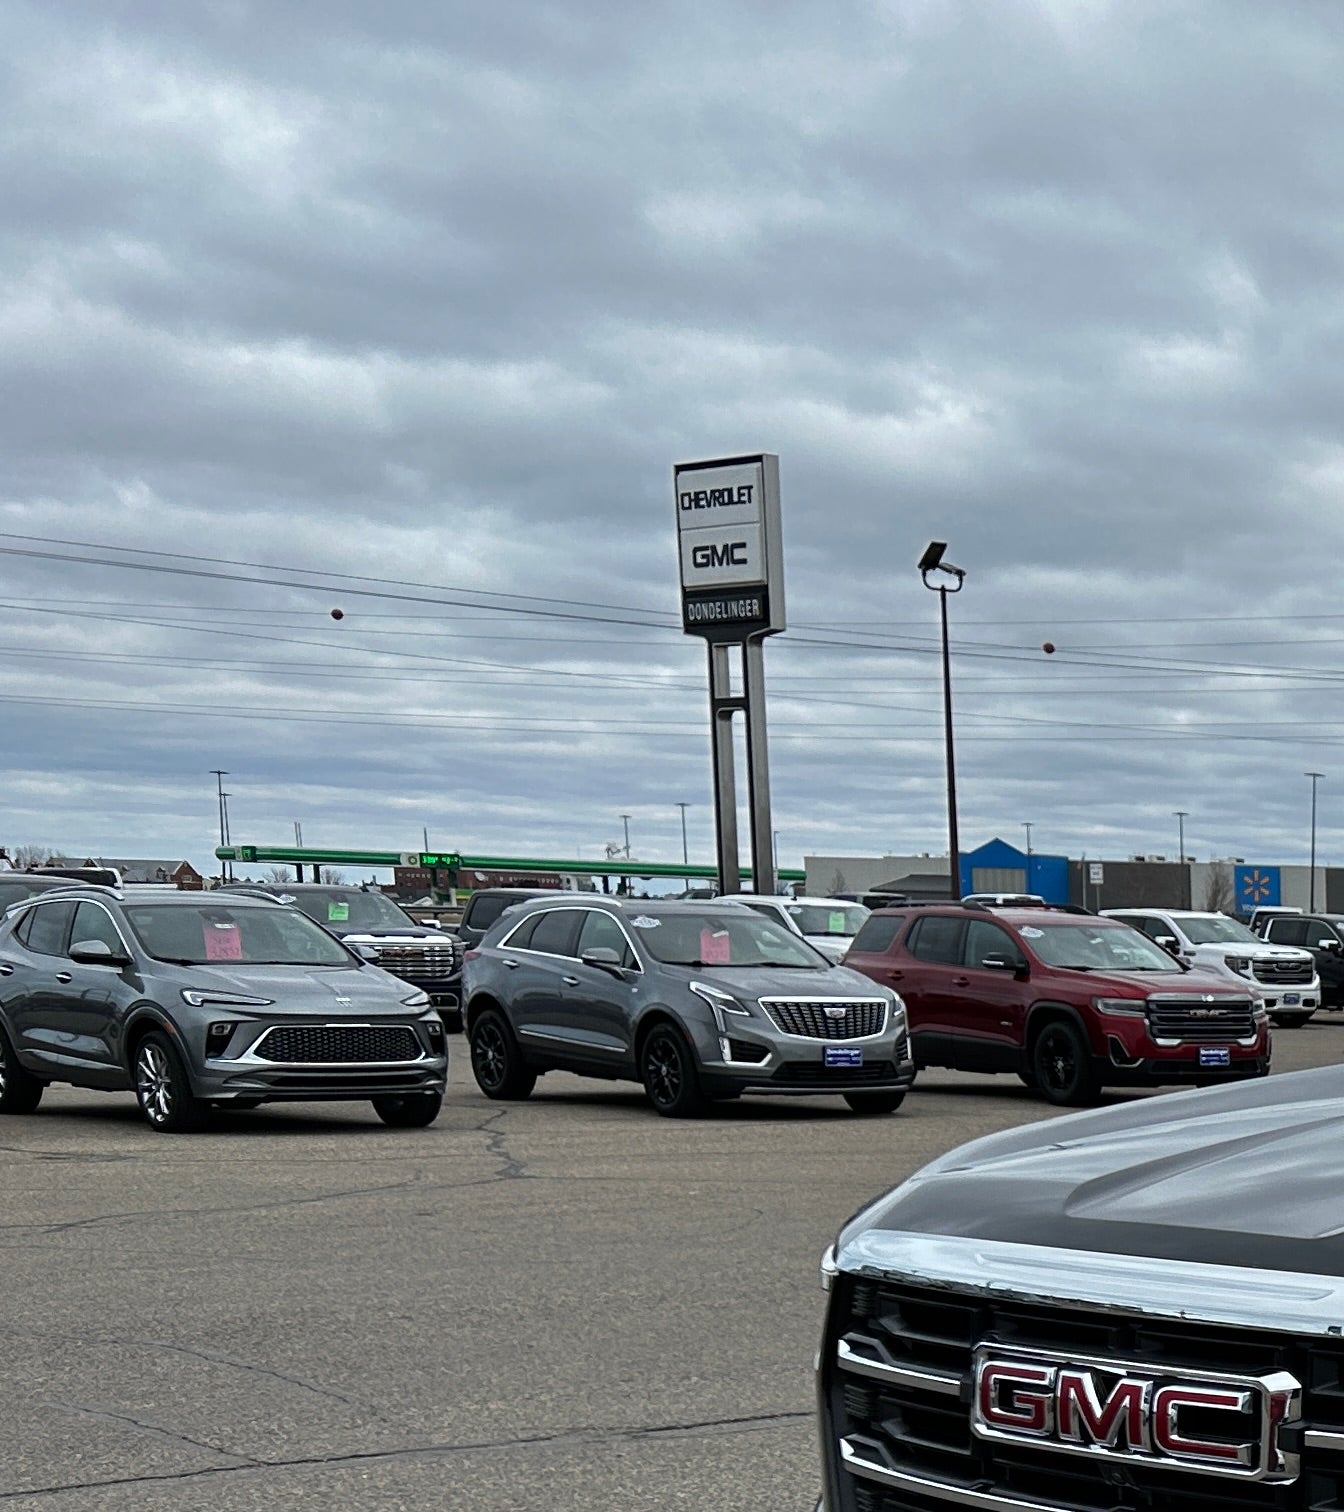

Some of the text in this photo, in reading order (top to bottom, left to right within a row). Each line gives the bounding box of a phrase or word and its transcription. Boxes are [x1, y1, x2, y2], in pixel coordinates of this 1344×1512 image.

[680, 485, 753, 511] CHEVROLET
[692, 542, 748, 568] GMC
[688, 599, 760, 620] DONDELINGER
[979, 1360, 1254, 1467] GMC
